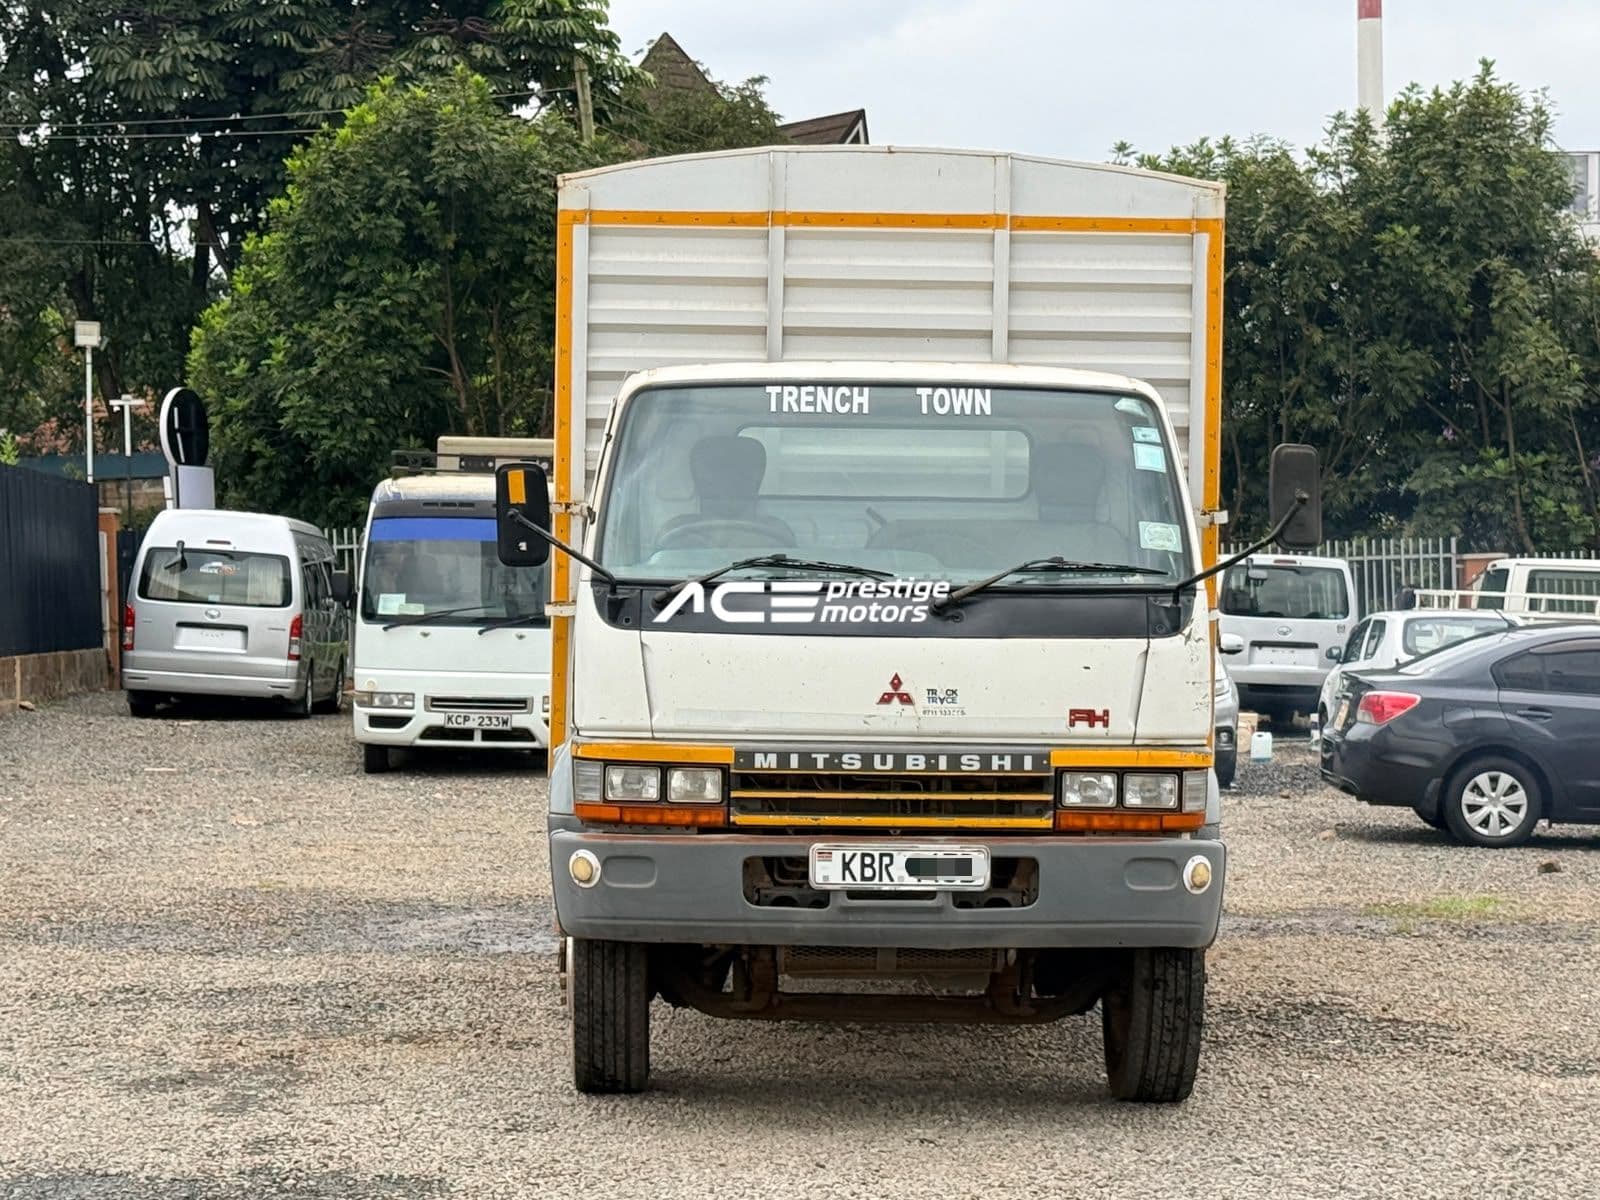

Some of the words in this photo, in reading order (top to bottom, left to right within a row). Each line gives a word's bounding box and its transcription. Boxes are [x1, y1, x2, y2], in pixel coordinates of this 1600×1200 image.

[765, 386, 870, 414] TRENCH
[916, 387, 992, 416] TOWN
[926, 688, 959, 697] TRCK
[446, 714, 471, 726] KCP
[477, 715, 509, 728] 233W
[753, 752, 1034, 772] MITSUBISHI
[841, 852, 895, 883] KBR
